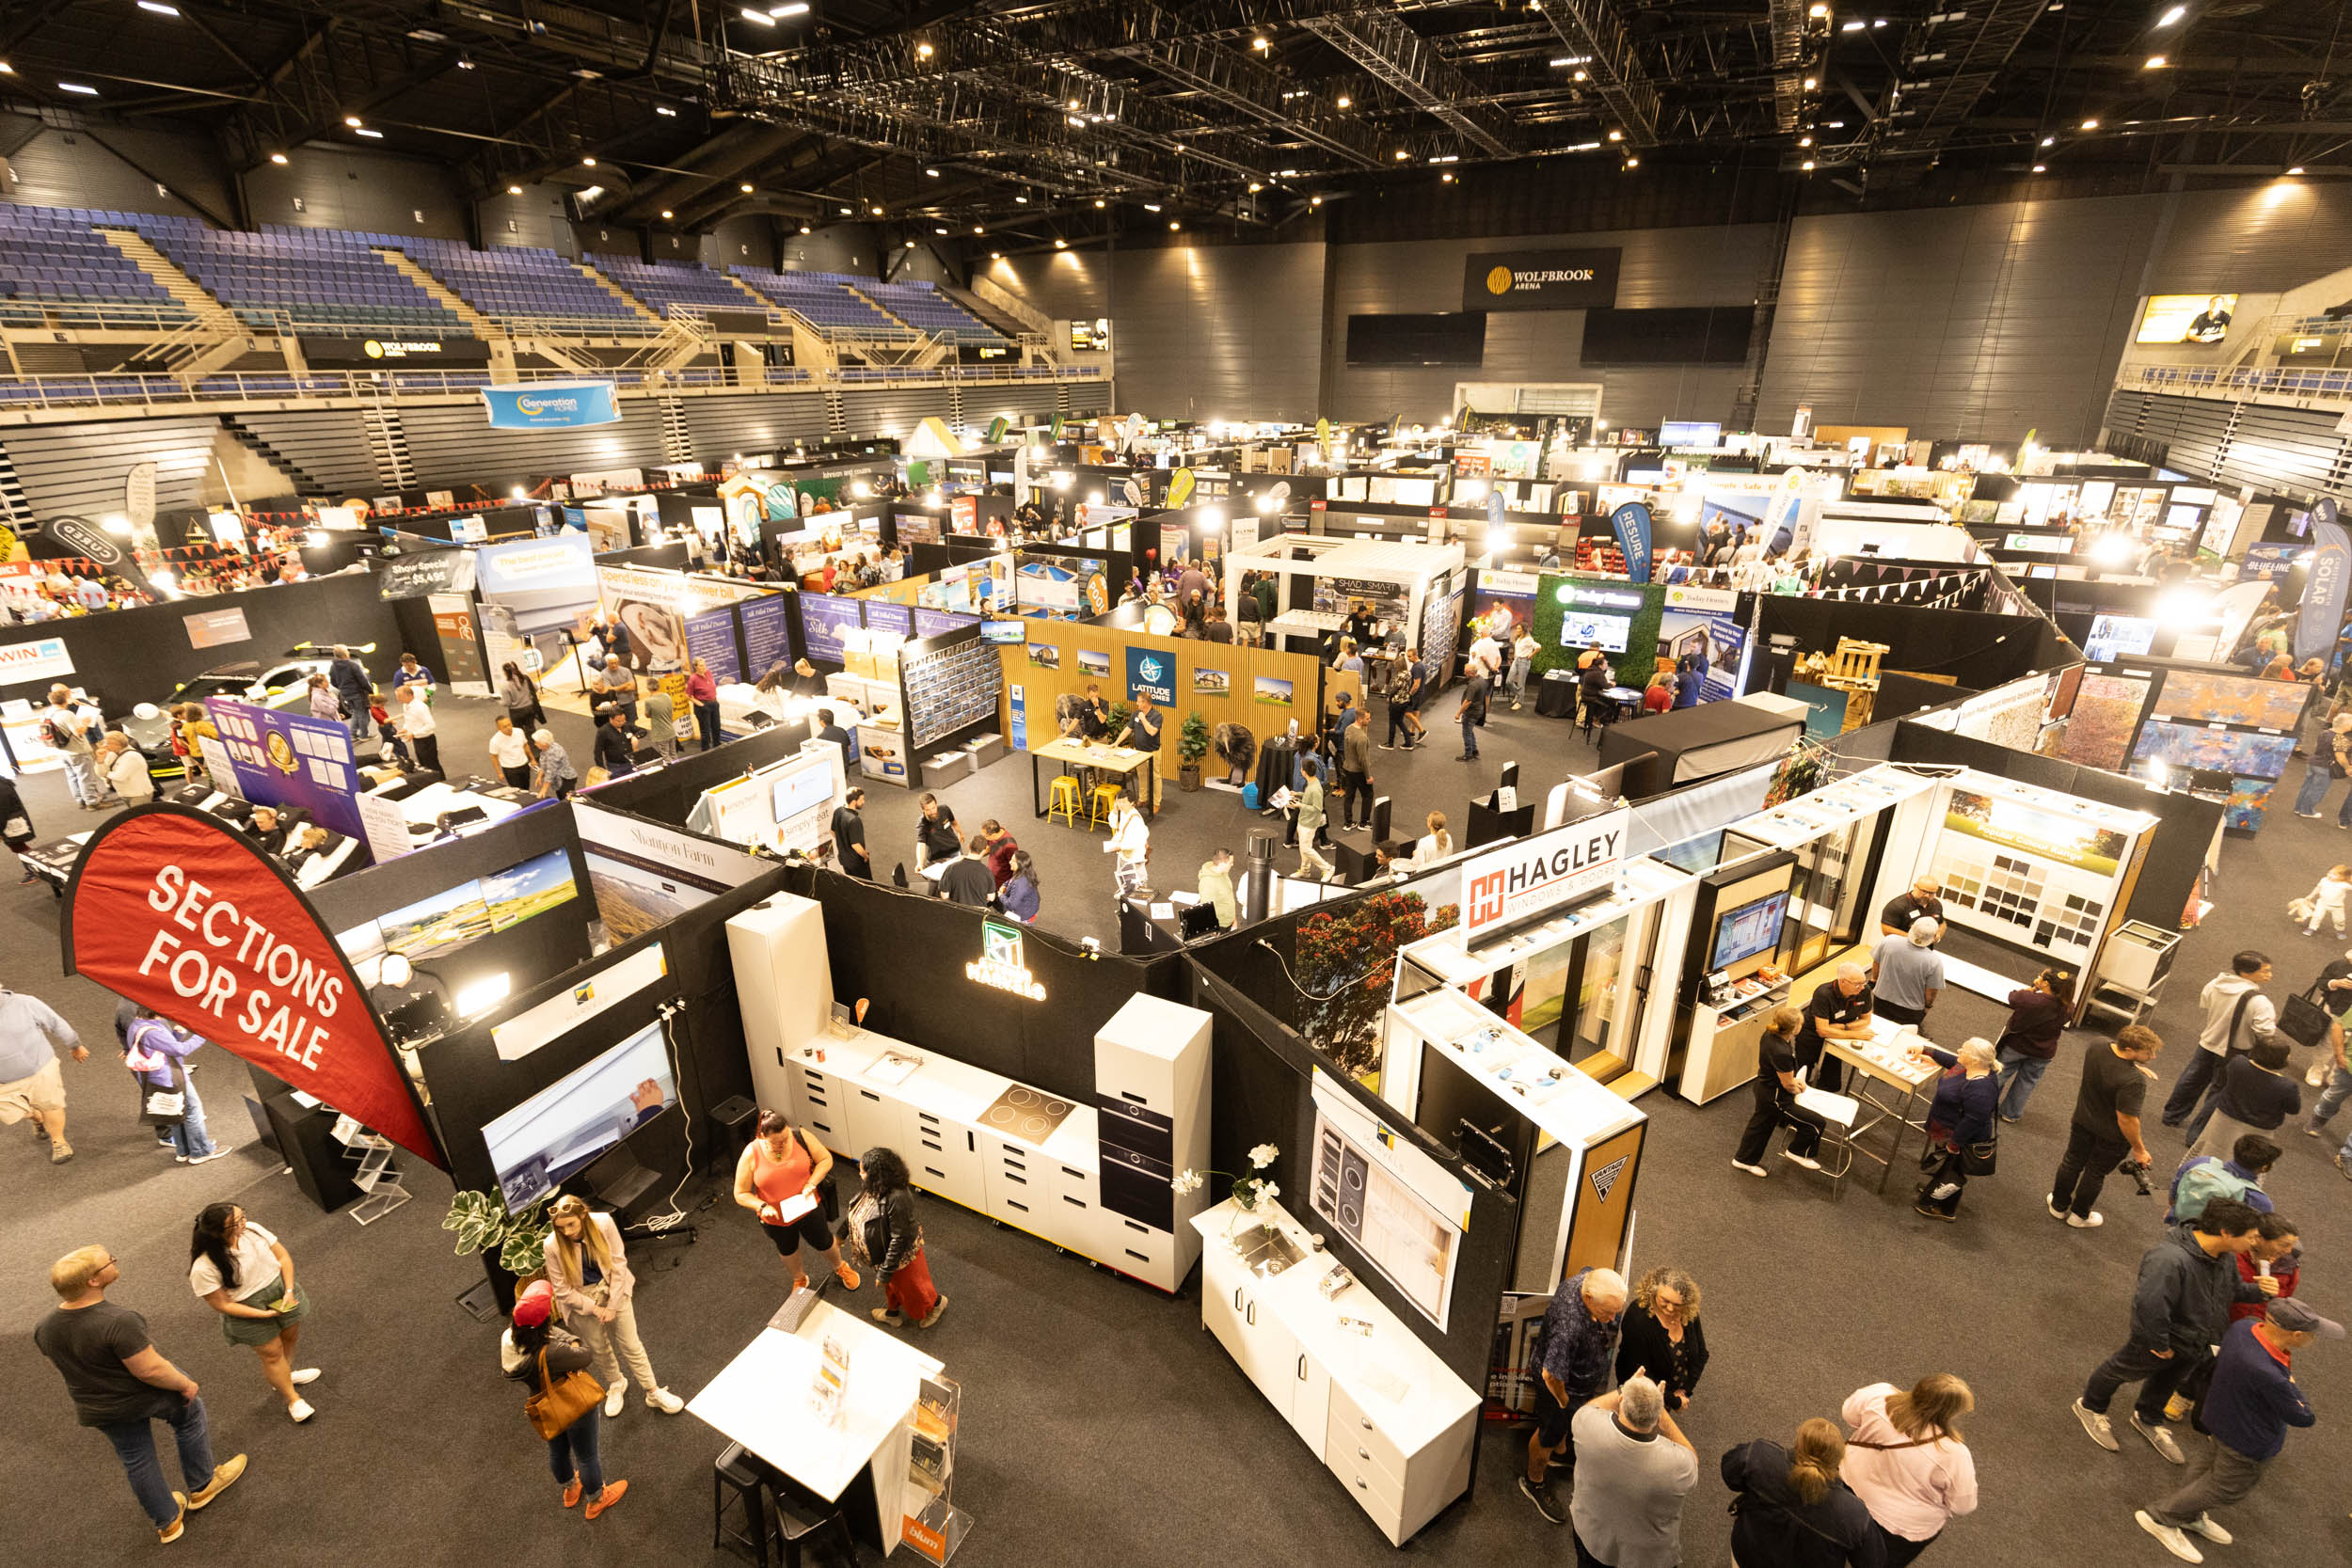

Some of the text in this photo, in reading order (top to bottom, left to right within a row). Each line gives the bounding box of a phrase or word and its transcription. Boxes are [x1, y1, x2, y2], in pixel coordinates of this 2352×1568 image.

[1514, 269, 1593, 282] WOLFBROOK
[522, 397, 577, 407] Generation
[1622, 511, 1645, 560] RESURE
[391, 559, 449, 574] Show Special
[2247, 561, 2291, 573] BLUELINE
[600, 568, 630, 585] Spend
[631, 572, 648, 586] less
[720, 587, 739, 600] bill.
[1367, 581, 1396, 591] SMART
[2311, 556, 2334, 606] SOLAR
[1089, 580, 1105, 614] POOL
[1687, 594, 1705, 603] Today
[809, 621, 829, 635] Silk
[1132, 683, 1170, 696] LATITUDE
[1152, 693, 1170, 702] OMES
[631, 826, 716, 866] Shannon Farm
[1978, 825, 2012, 841] Popular
[2051, 846, 2084, 862] Range
[1509, 831, 1619, 894] HAGLEY
[1506, 864, 1615, 913] WINDOWS & DOORS
[147, 864, 343, 1019] SECTIONS
[137, 929, 330, 1071] FOR SALE
[1594, 1160, 1624, 1180] VANTAGE
[910, 1526, 939, 1550] blum
